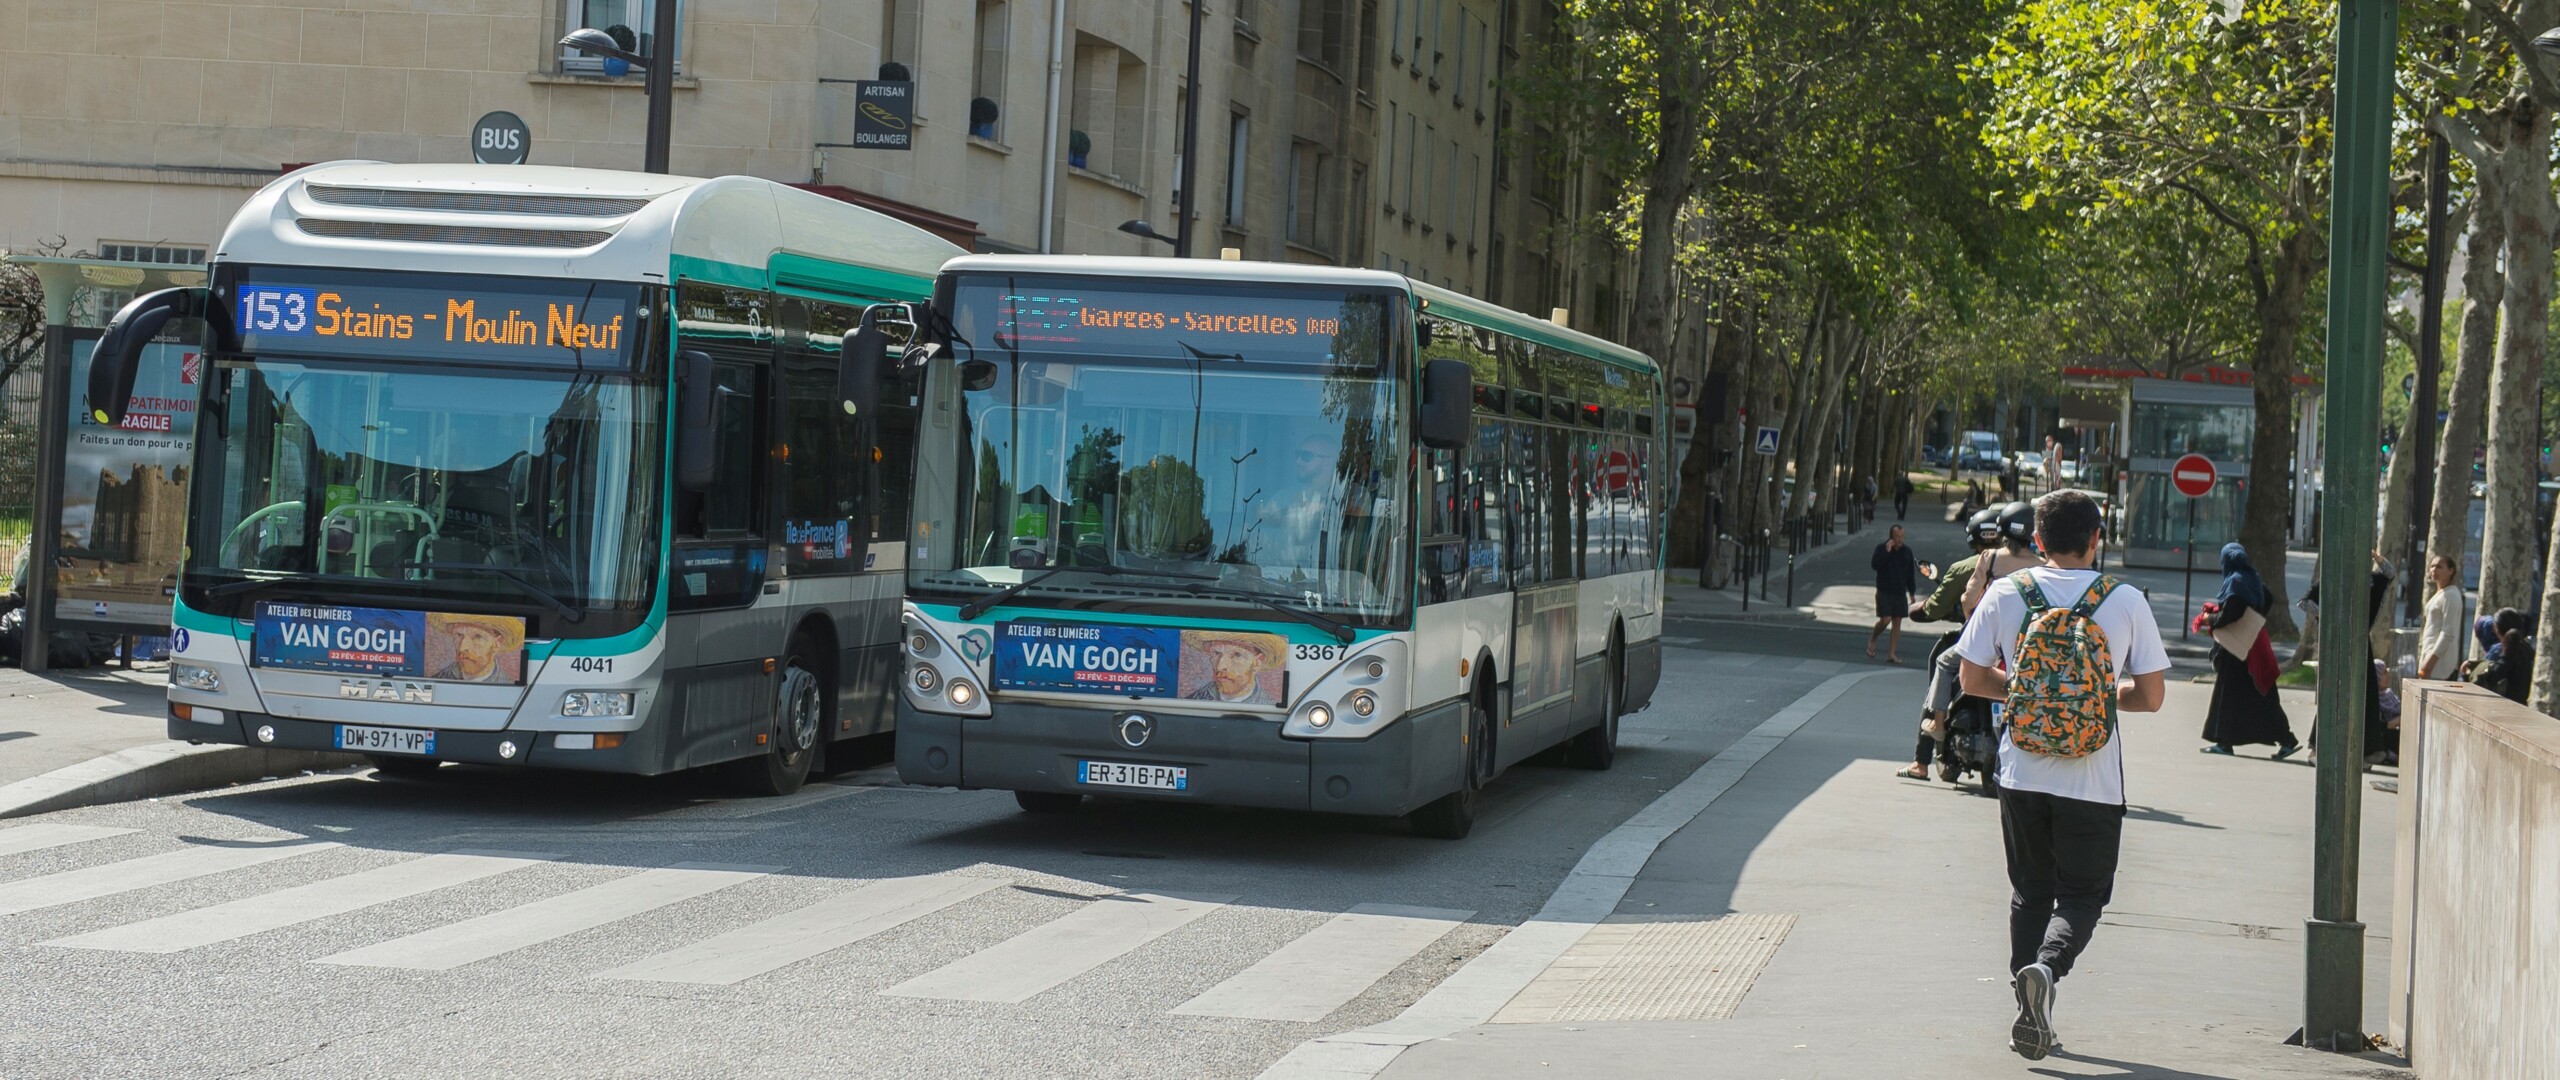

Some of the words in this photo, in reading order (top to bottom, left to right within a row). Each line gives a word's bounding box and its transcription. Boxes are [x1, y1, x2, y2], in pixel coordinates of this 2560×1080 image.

[864, 86, 905, 97] ARTISAN
[481, 128, 520, 150] BUS
[856, 133, 907, 144] BOULANGER
[243, 291, 306, 331] 153
[315, 292, 413, 339] Stains
[445, 298, 537, 345] Moulin
[546, 303, 622, 349] Neuf
[694, 306, 715, 320] MAN
[1081, 307, 1165, 329] Garges
[1185, 311, 1298, 335] Sarcelles
[1306, 317, 1339, 337] (RER)
[130, 396, 195, 412] PATRIMOI
[122, 415, 169, 430] RAGILE
[80, 434, 109, 445] Faites
[112, 437, 125, 445] un
[127, 437, 146, 446] don
[148, 440, 171, 449] pour
[174, 440, 184, 449] le
[267, 605, 298, 617] ATELIER
[300, 608, 312, 618] DES
[313, 608, 352, 621] LUMIÈRES
[280, 622, 329, 648] VAN
[336, 626, 405, 653] GOGH
[1008, 625, 1041, 637] ATELIER
[1044, 628, 1056, 637] DES
[1058, 627, 1100, 640] LUMIÈRES
[331, 652, 340, 660] 22
[341, 652, 356, 660] FÉV.
[370, 654, 385, 663] DÉC.
[1021, 642, 1075, 668] VAN
[1083, 646, 1158, 673] GOGH
[1295, 644, 1349, 661] 3367
[571, 657, 613, 673] 4041
[1087, 673, 1102, 681] FÉV.
[1108, 674, 1116, 682] 31
[1118, 674, 1135, 683] DÉC.
[1136, 676, 1154, 684] 2019
[340, 679, 433, 703] MAN
[346, 728, 424, 750] DW-971-VP
[426, 743, 434, 751] 75
[1088, 764, 1175, 787] ER-316-PA
[1177, 780, 1185, 788] 75
